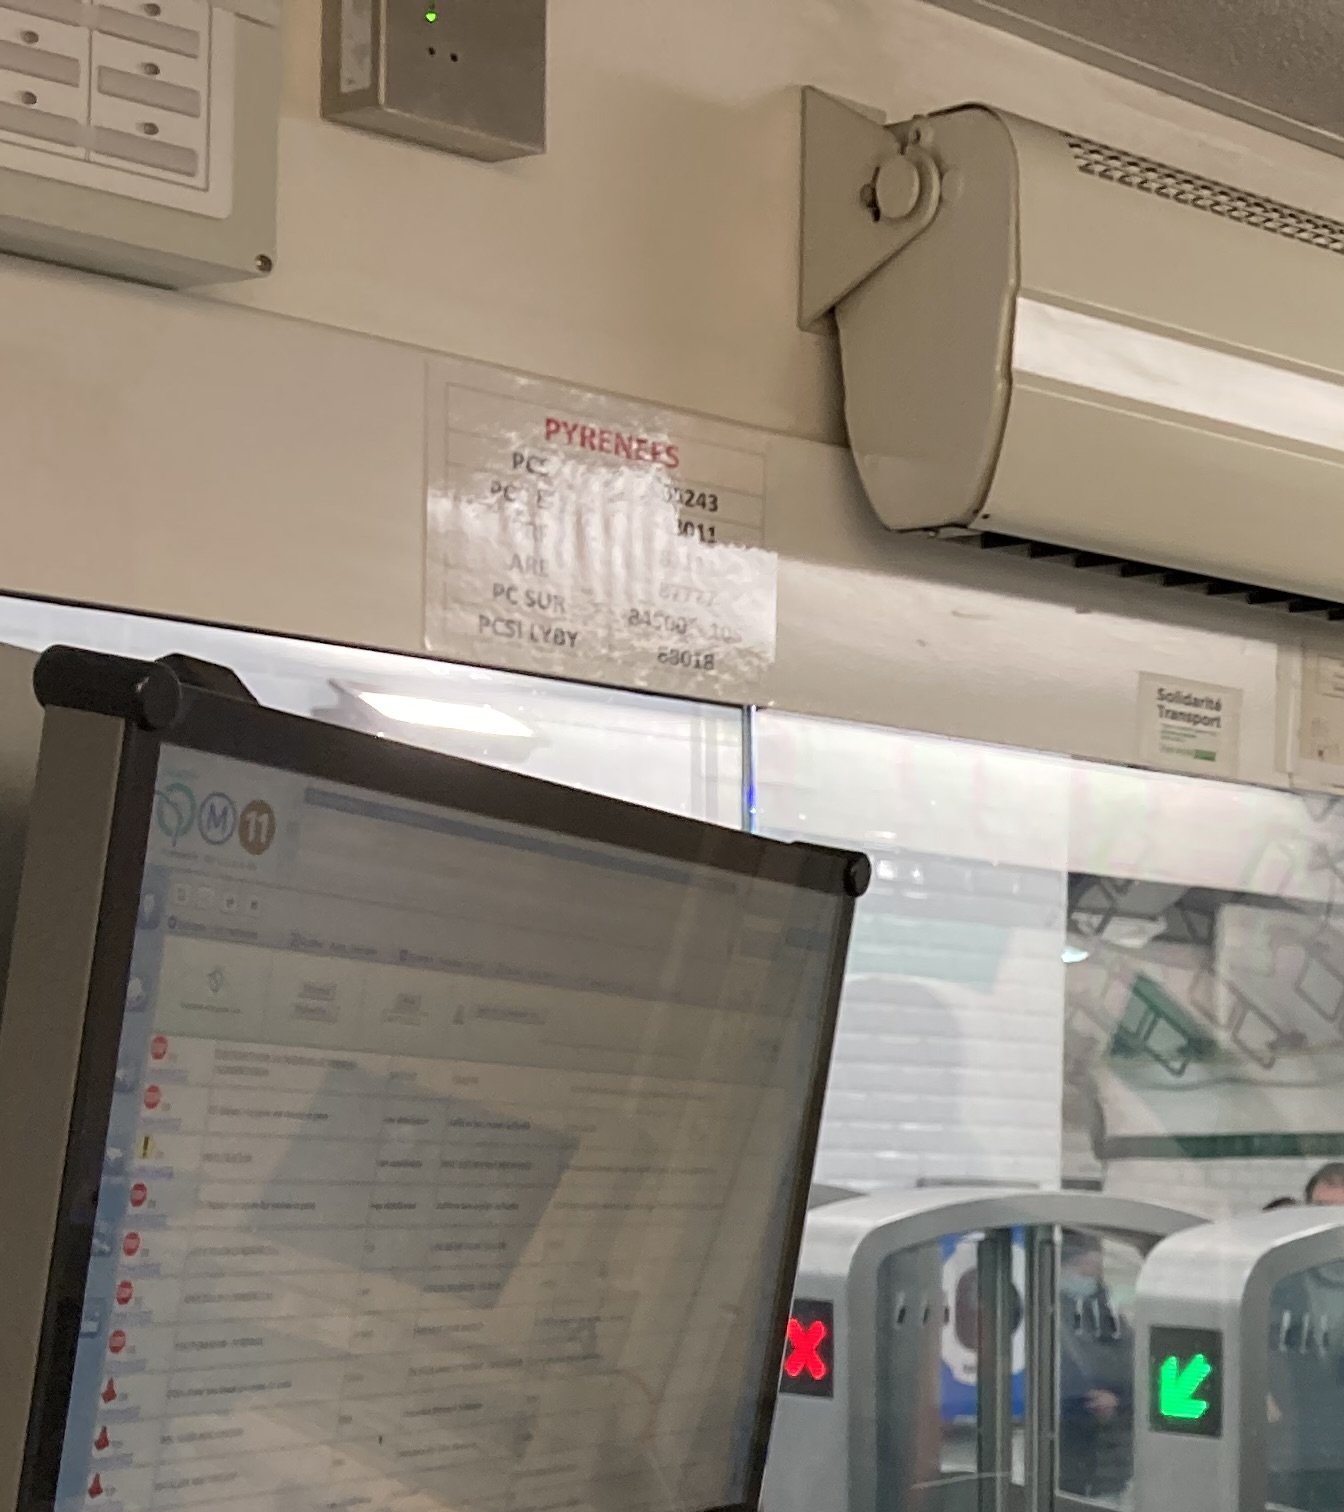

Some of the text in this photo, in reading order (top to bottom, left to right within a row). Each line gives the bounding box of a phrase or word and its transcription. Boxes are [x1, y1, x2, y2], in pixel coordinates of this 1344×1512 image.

[545, 417, 679, 468] PYRENEES
[1157, 687, 1222, 711] Solidarité
[1157, 703, 1221, 728] Transport
[243, 811, 268, 843] 11
